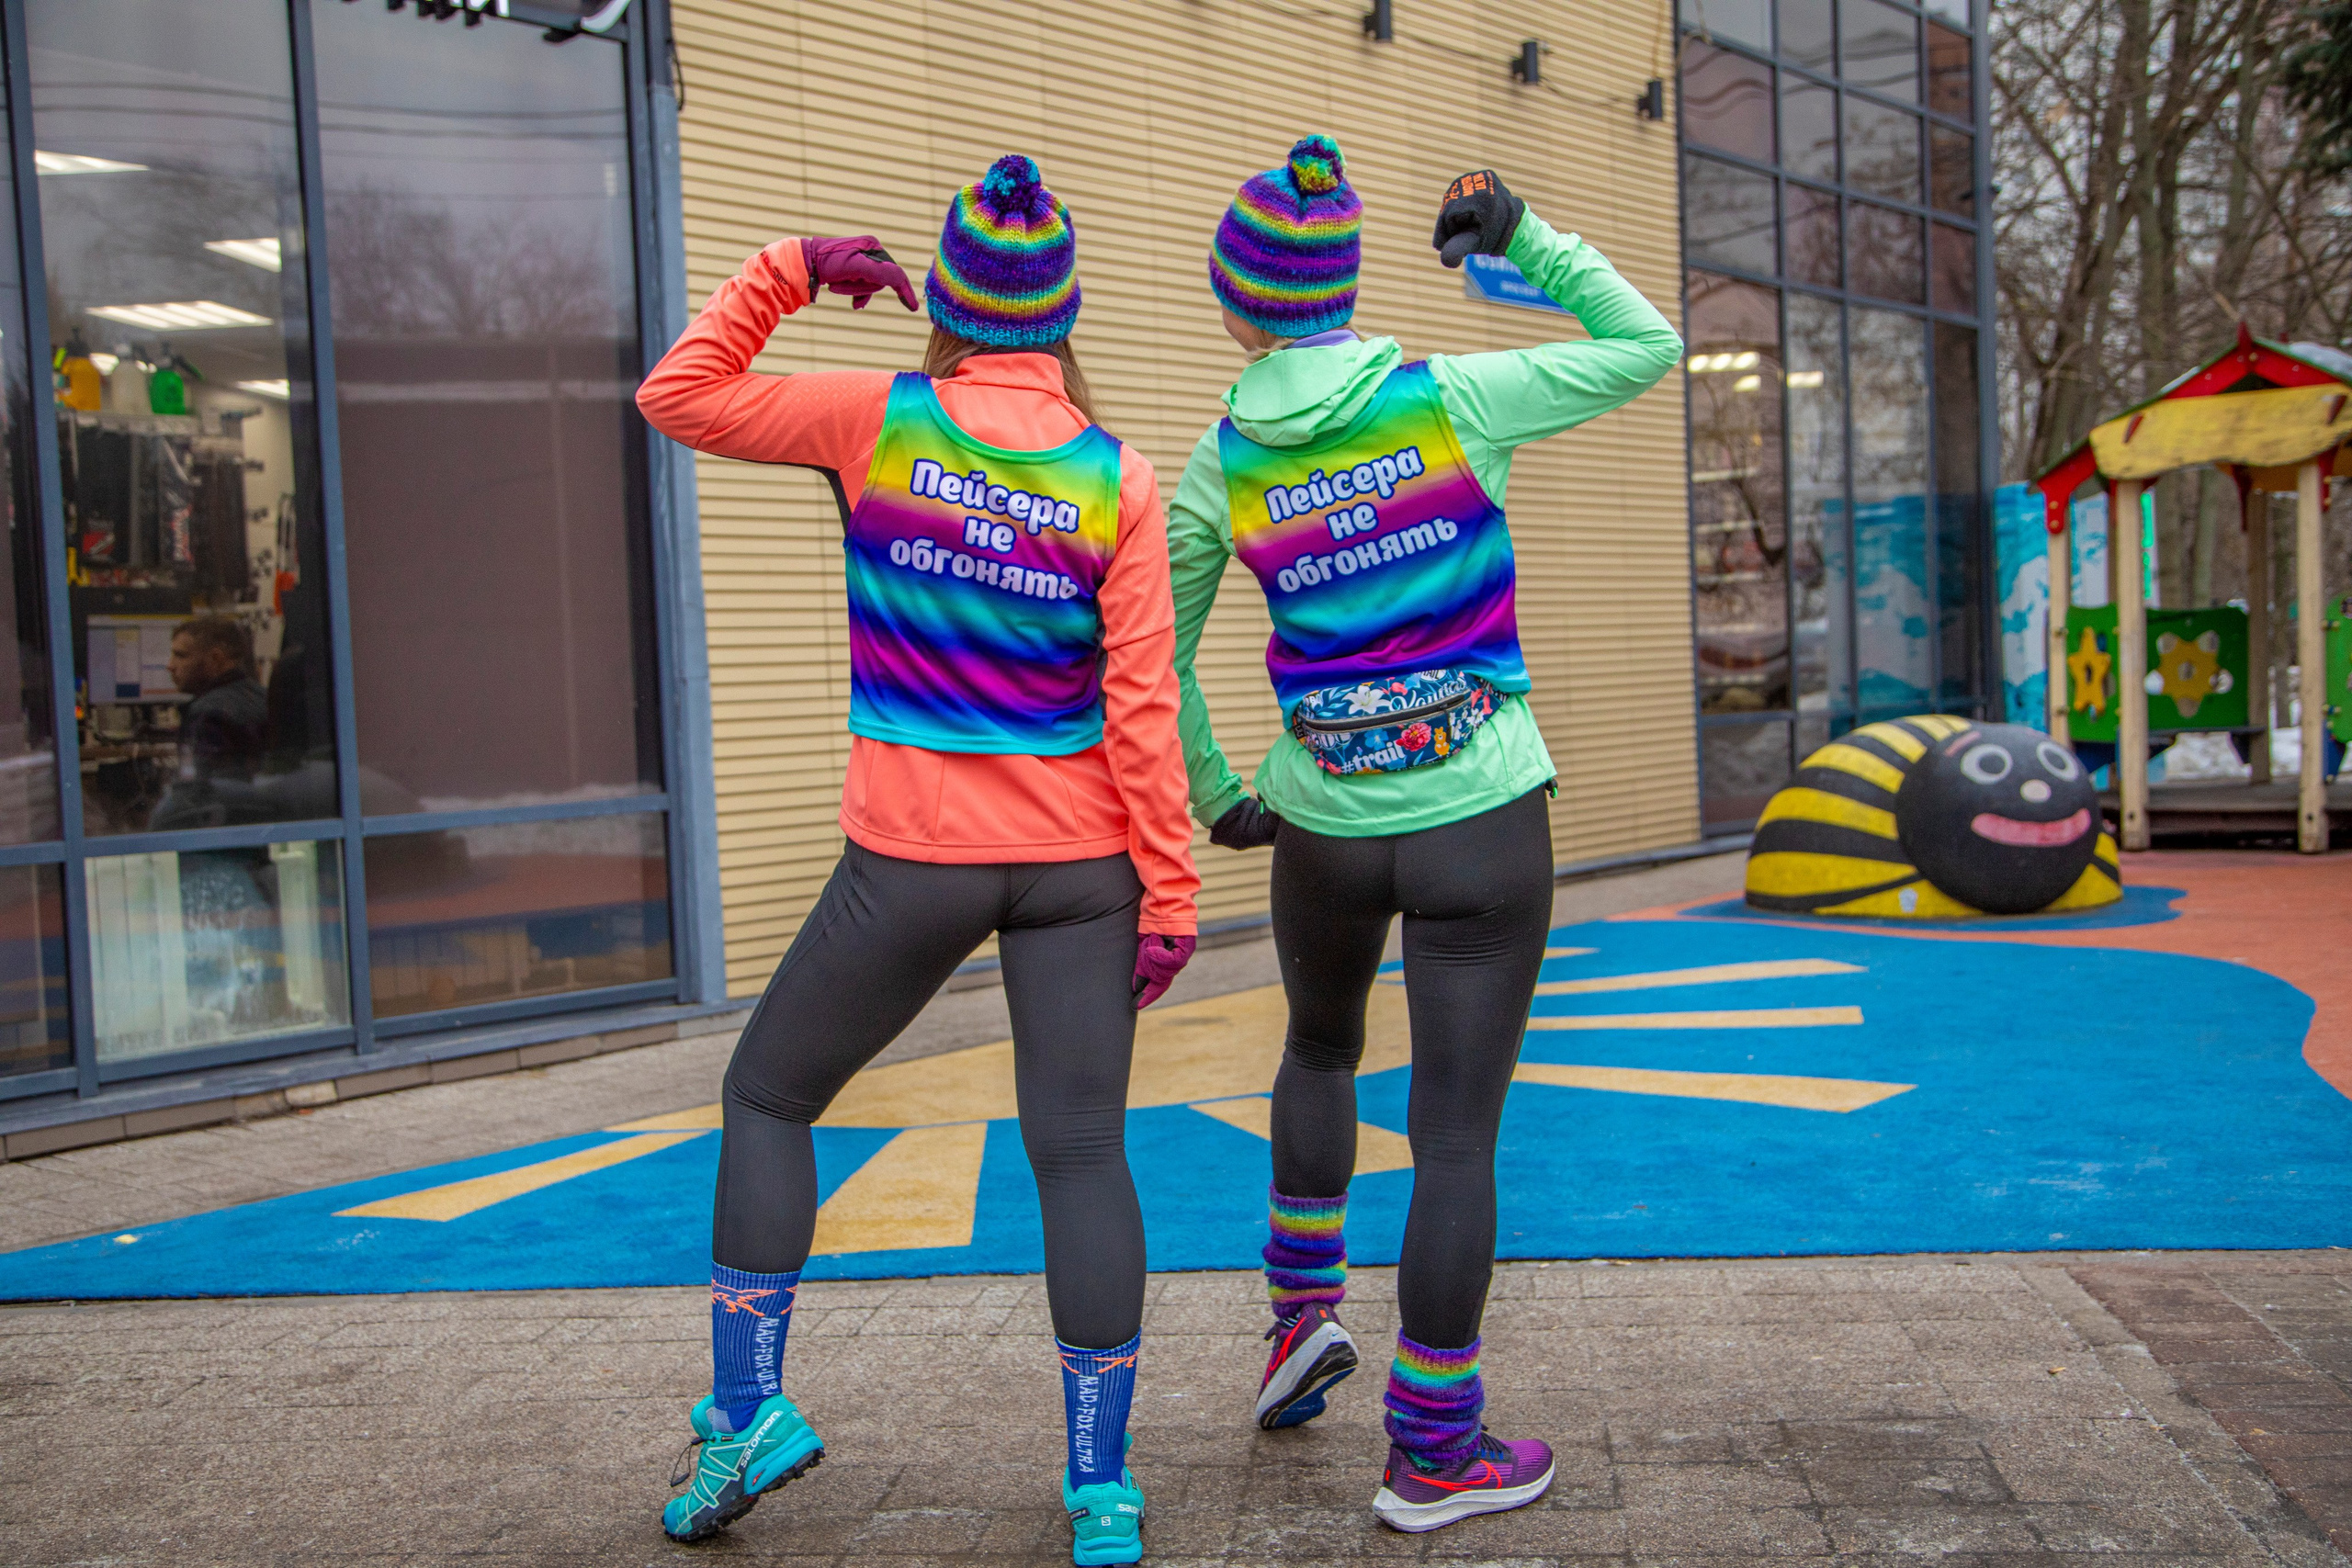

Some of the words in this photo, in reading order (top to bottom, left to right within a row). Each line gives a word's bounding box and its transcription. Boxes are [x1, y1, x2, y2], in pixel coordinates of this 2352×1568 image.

[910, 458, 1080, 536] Пейсера
[1265, 446, 1425, 524] Пейсера
[963, 516, 1015, 553] не
[1325, 502, 1379, 540] не
[888, 538, 1080, 601] обгонять
[1276, 516, 1459, 593] обгонять
[1341, 740, 1407, 774] #trail
